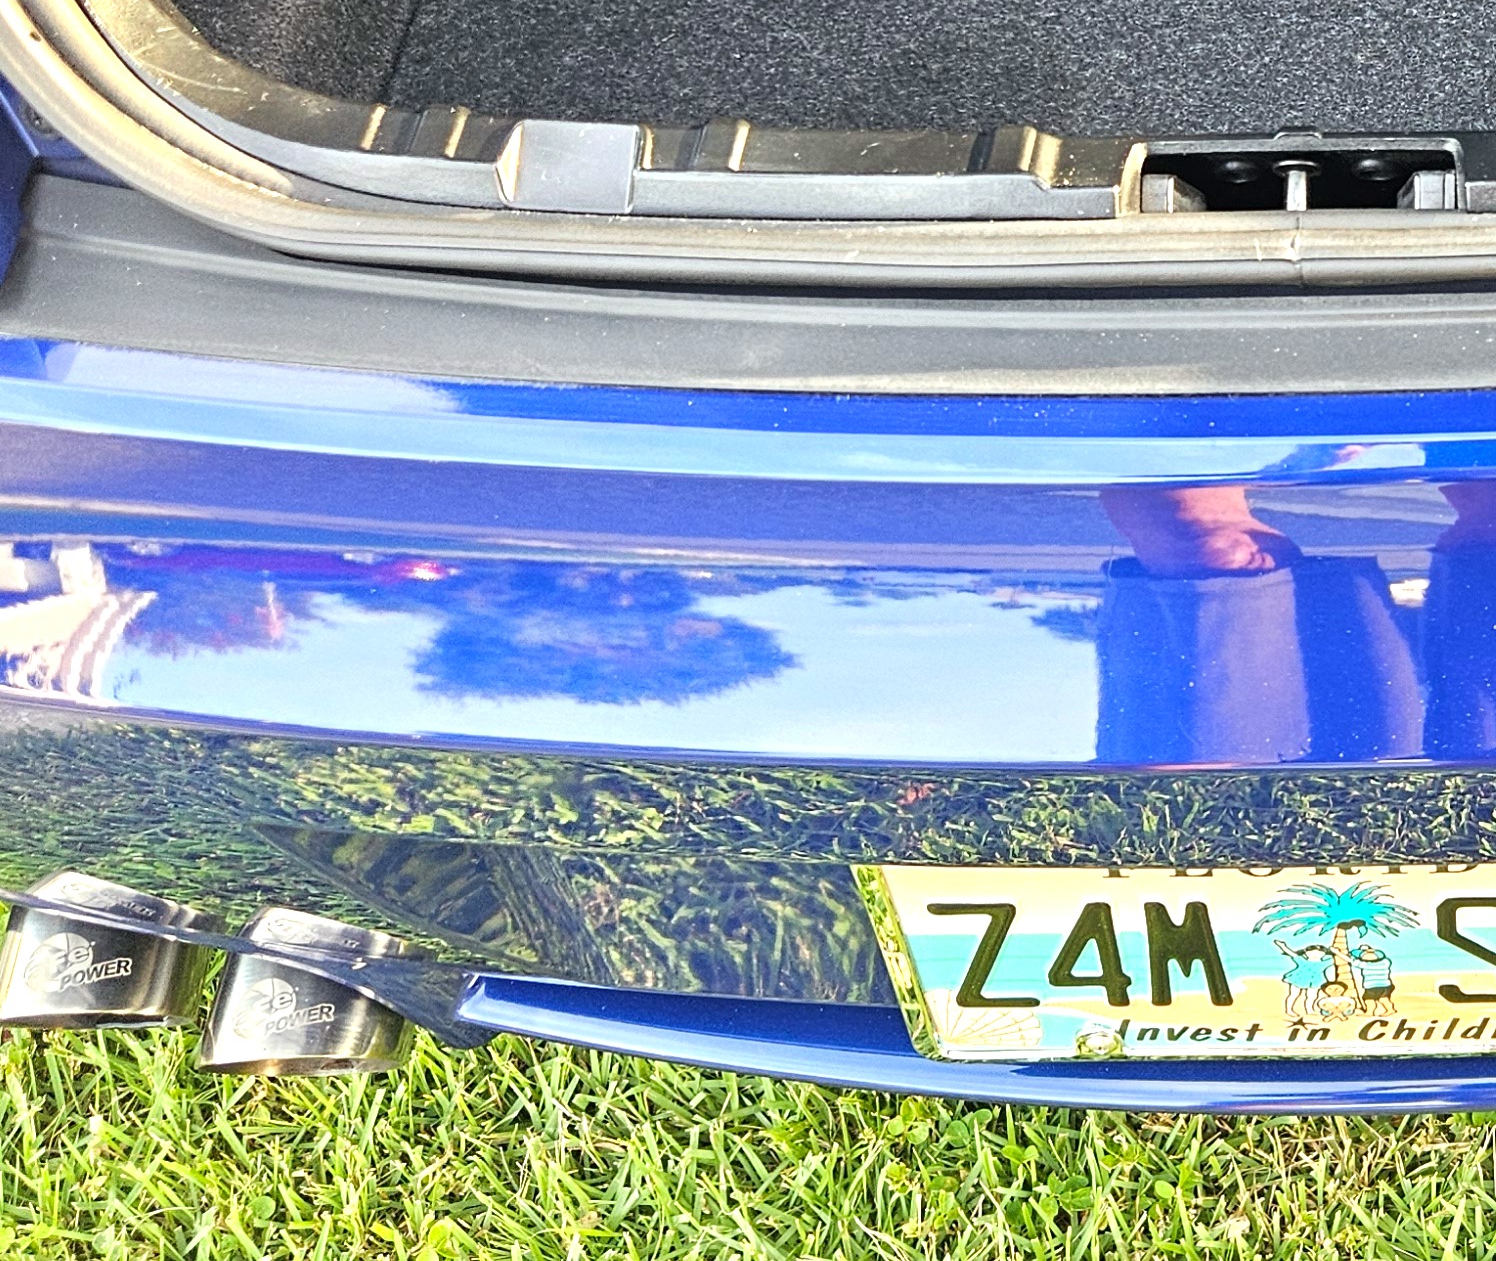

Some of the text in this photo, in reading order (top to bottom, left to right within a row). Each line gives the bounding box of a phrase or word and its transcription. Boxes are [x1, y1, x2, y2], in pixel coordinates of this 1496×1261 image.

[927, 901, 1234, 1008] Z4M
[59, 958, 132, 990] POWER
[264, 1005, 334, 1037] POWER
[1115, 1018, 1264, 1042] Invest
[1288, 1018, 1331, 1042] in
